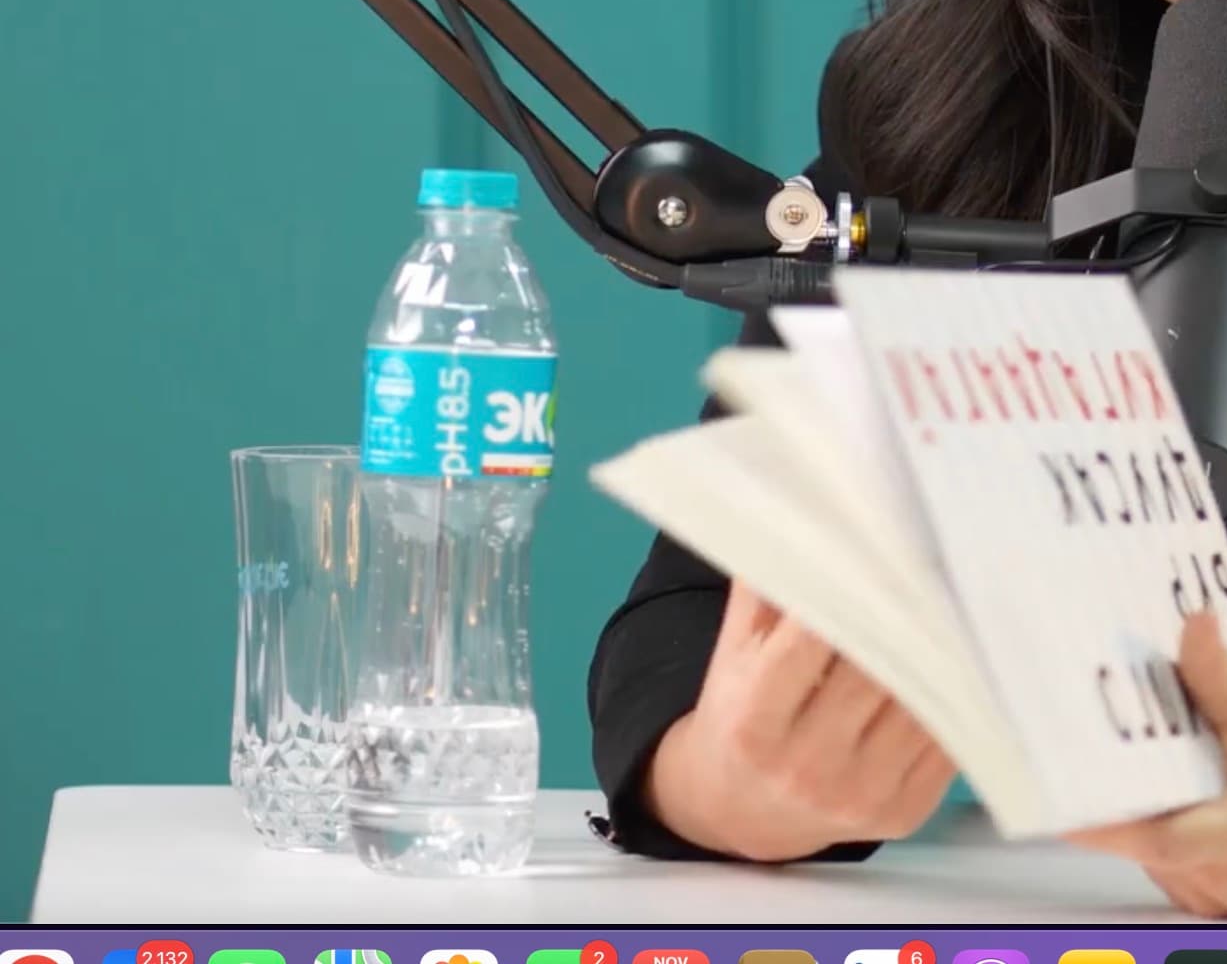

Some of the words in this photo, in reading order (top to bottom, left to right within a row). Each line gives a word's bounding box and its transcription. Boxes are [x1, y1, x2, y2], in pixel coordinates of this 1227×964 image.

[483, 390, 555, 448] ЭК
[141, 950, 188, 964] 2132
[593, 950, 605, 964] 2
[653, 955, 689, 964] NOV
[910, 950, 923, 964] 6
